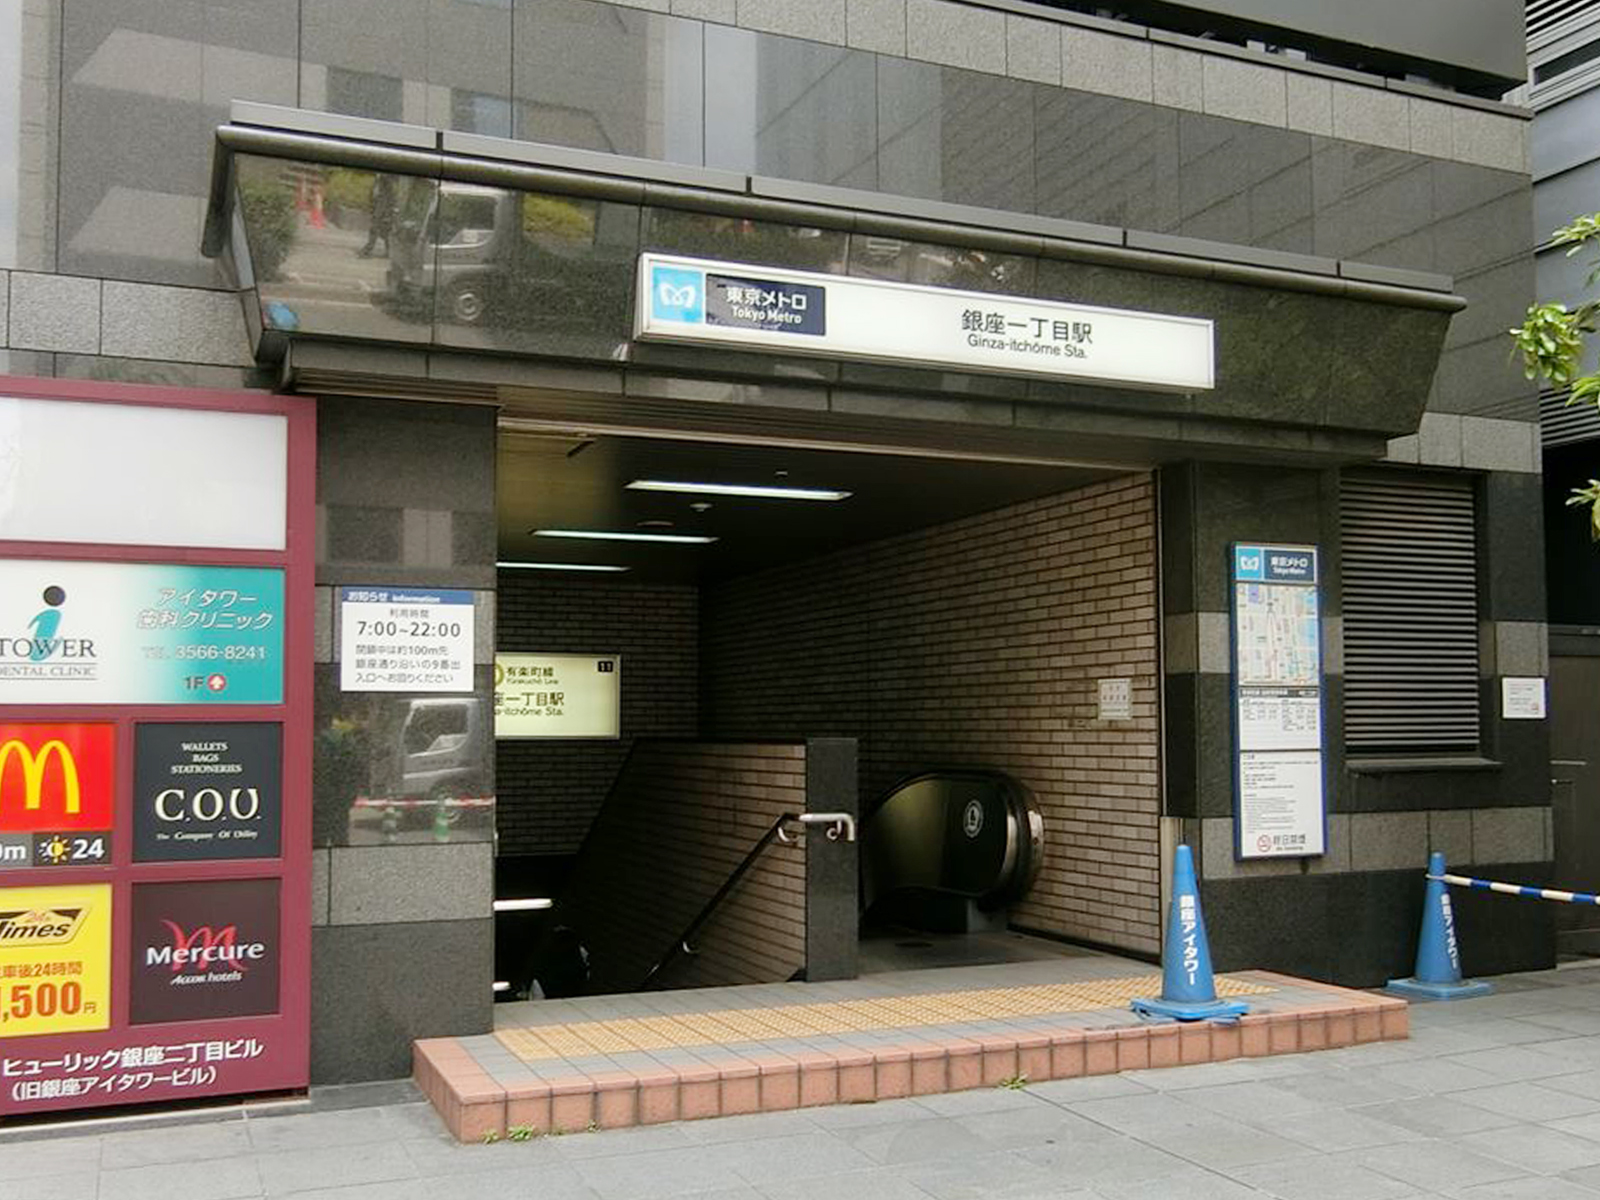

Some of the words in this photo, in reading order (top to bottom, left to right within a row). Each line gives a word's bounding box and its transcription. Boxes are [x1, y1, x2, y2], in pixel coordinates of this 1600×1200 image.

[726, 286, 807, 310] 東京メトロ
[732, 306, 766, 321] Tokyo
[768, 309, 802, 324] Metro
[961, 309, 1093, 344] 銀座一丁目駅
[1064, 344, 1088, 358] Sta.
[159, 587, 258, 608] アイタワー
[137, 610, 274, 629] 歯科クリニック
[176, 645, 265, 660] 3566-8241
[50, 667, 96, 677] CLINIC
[184, 677, 204, 690] 1F
[181, 742, 228, 751] WALLETS
[192, 754, 220, 762] BAGS
[171, 764, 242, 774] STATIONERIES
[72, 839, 105, 859] 24
[146, 943, 265, 965] Mercure
[208, 971, 242, 982] hotels
[3, 1039, 264, 1077] ヒューリック銀座二丁目ビル
